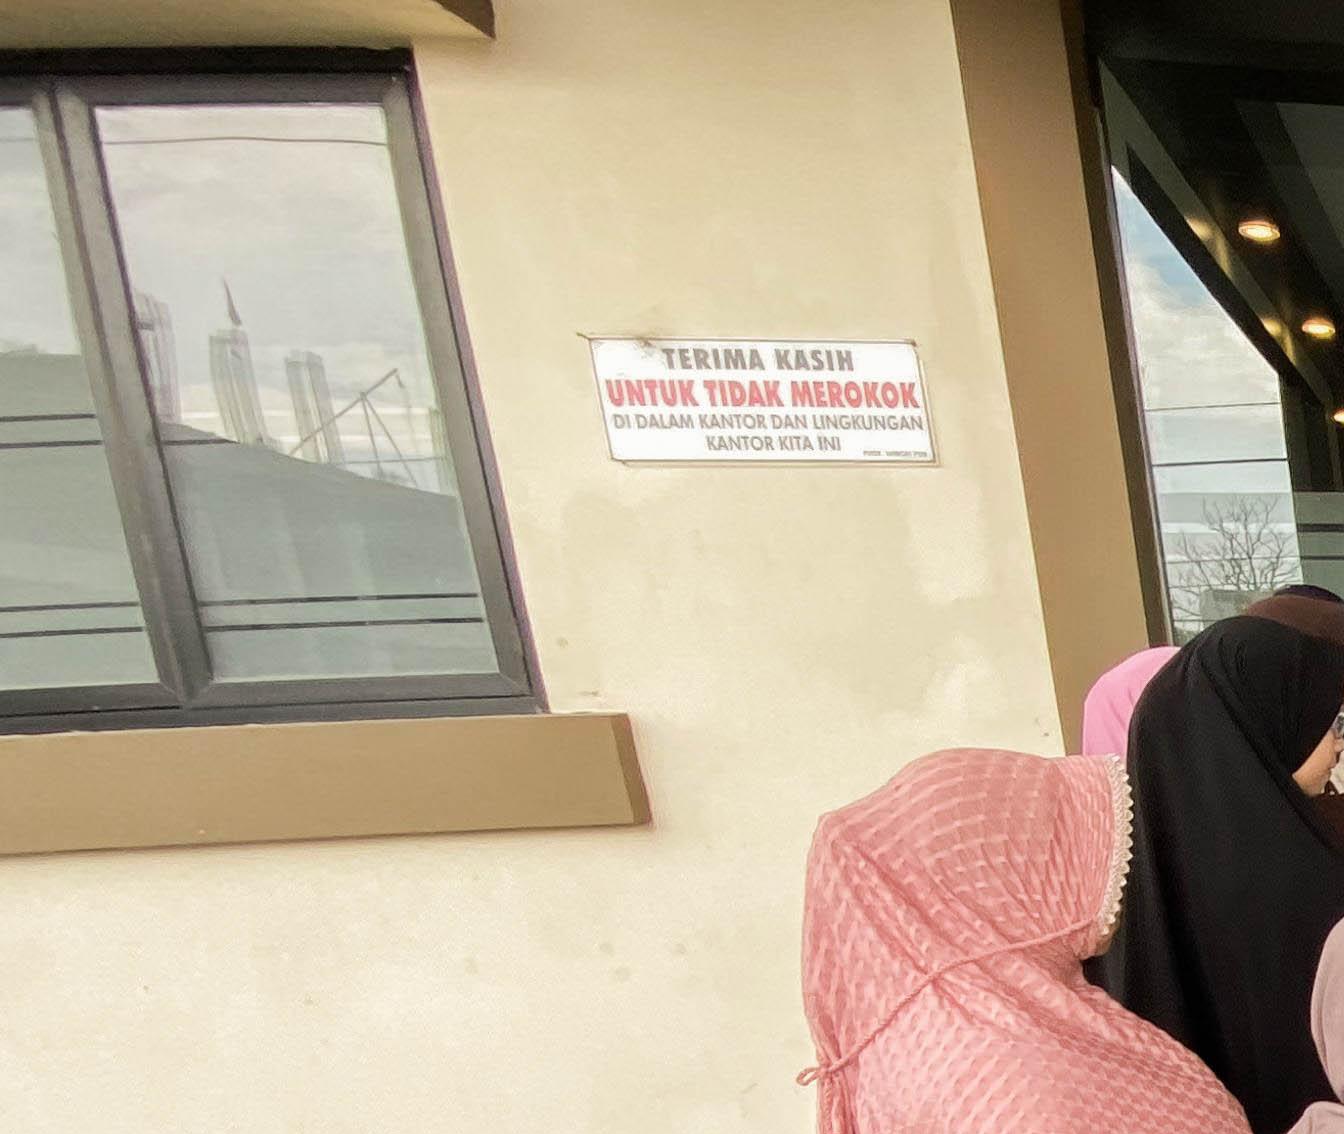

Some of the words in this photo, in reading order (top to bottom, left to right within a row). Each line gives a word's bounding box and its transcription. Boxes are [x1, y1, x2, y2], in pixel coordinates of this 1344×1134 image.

[662, 348, 766, 371] TERIMA
[775, 349, 855, 371] KASIH
[606, 379, 699, 407] UNTUK
[703, 380, 785, 408] TIDAK
[790, 381, 921, 409] MEROKOK
[613, 414, 632, 429] DI
[637, 414, 695, 430] DALAM
[699, 414, 768, 430] KANTOR
[772, 415, 810, 430] DAN
[813, 415, 924, 431] LINGKUNGAN
[707, 436, 776, 451] KANTOR
[779, 436, 814, 451] KITA
[819, 437, 842, 451] INI
